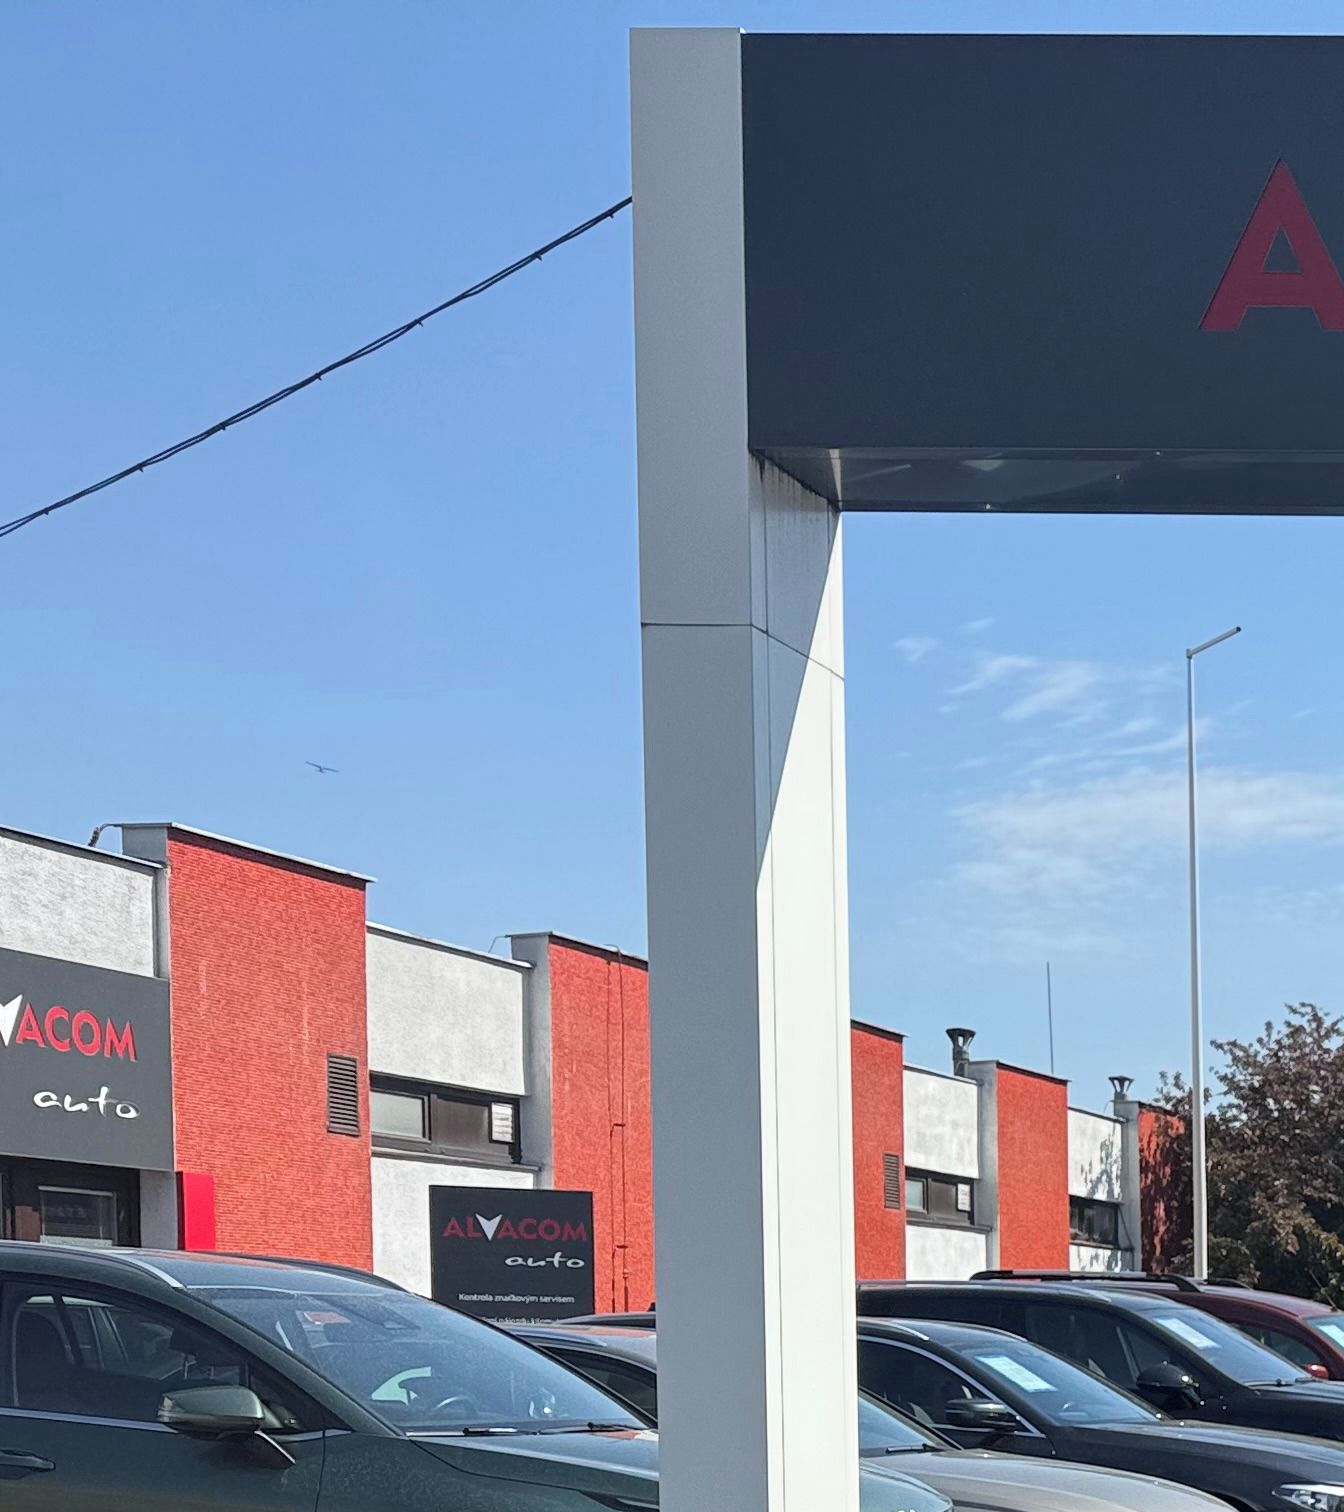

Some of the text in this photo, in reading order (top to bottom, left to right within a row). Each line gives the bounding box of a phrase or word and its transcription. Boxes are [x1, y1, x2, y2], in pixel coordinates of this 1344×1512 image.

[33, 1085, 141, 1119] auto
[442, 1213, 588, 1241] ALVACOM
[504, 1251, 585, 1268] auto
